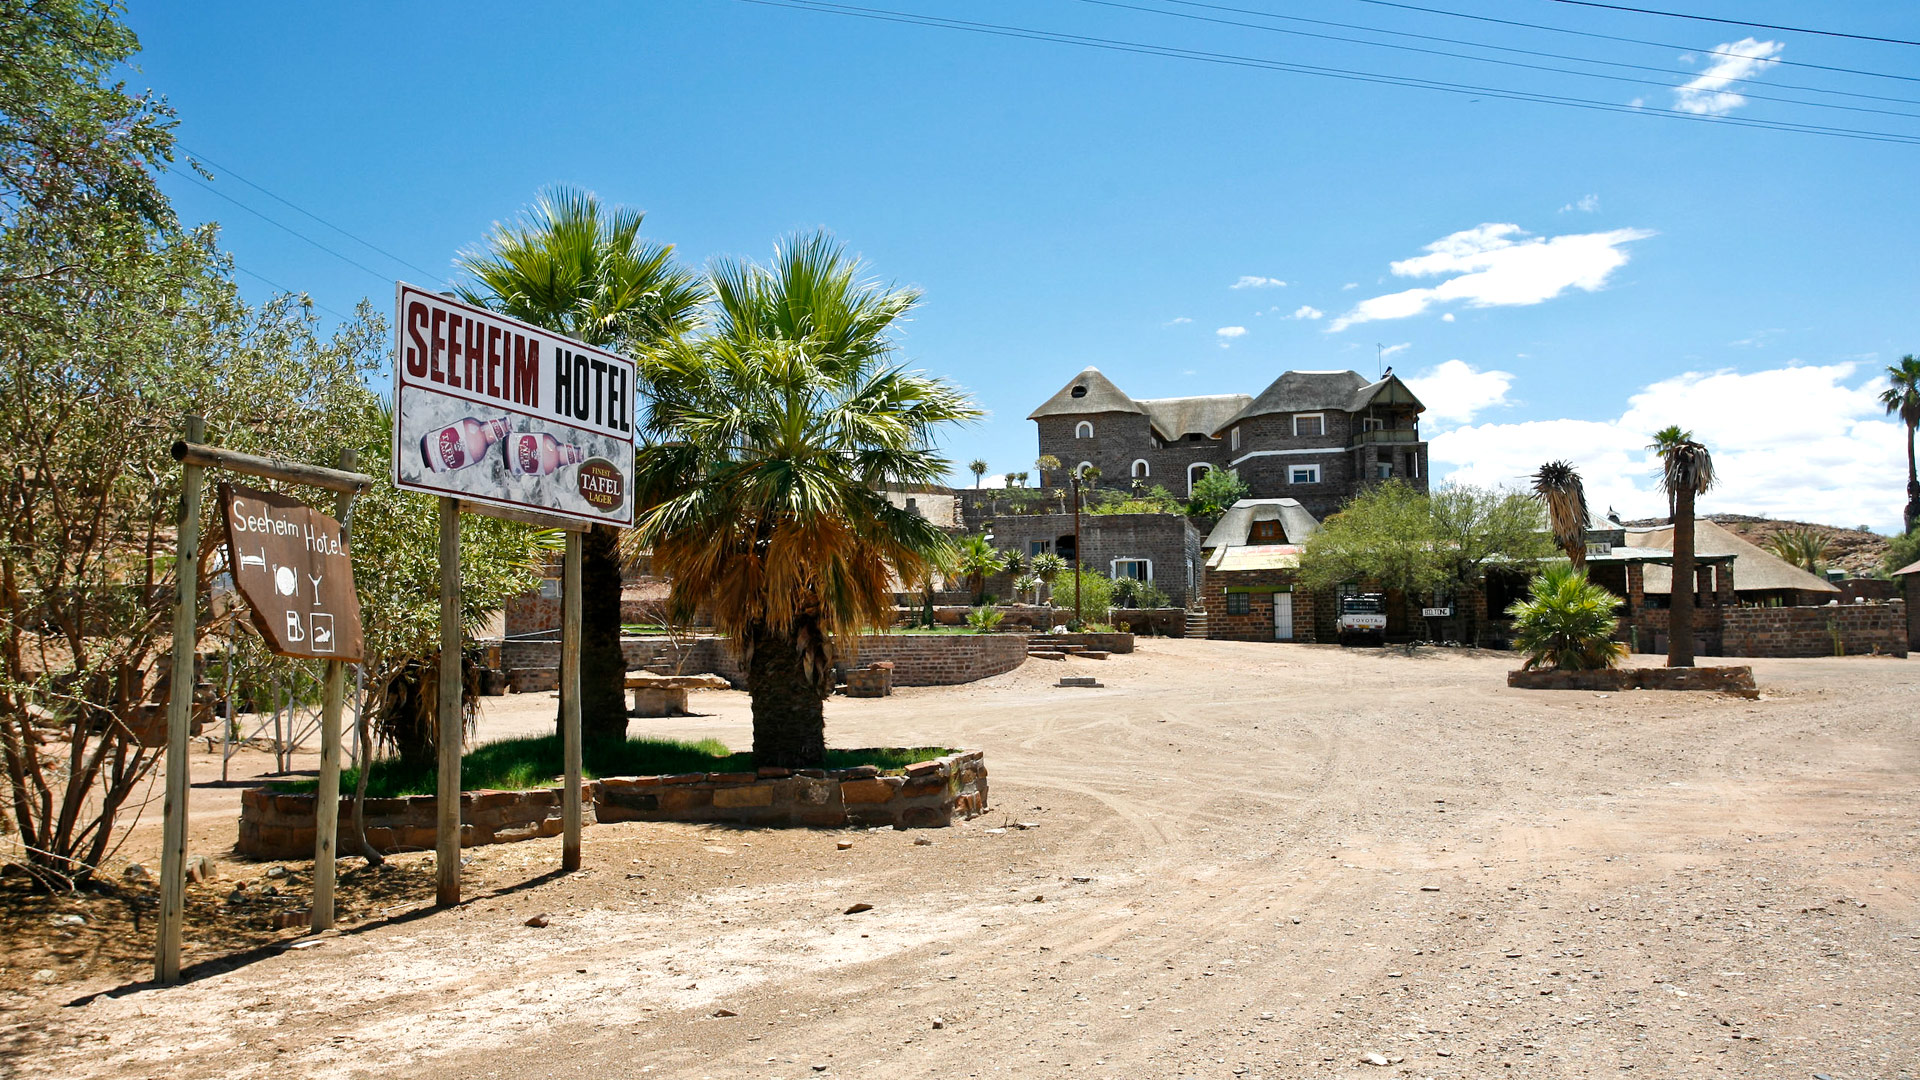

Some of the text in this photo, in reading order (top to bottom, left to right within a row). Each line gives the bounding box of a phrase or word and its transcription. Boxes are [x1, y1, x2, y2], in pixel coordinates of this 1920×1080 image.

[406, 301, 630, 433] SEEHEIM HOTEL
[441, 432, 456, 468] TAFEL
[522, 438, 531, 470] TAFEL
[581, 473, 621, 496] TAFEL
[592, 467, 611, 477] FINEST
[589, 492, 612, 505] LAGER
[233, 500, 346, 557] Seeheim Hotel
[1586, 543, 1610, 554] TEL
